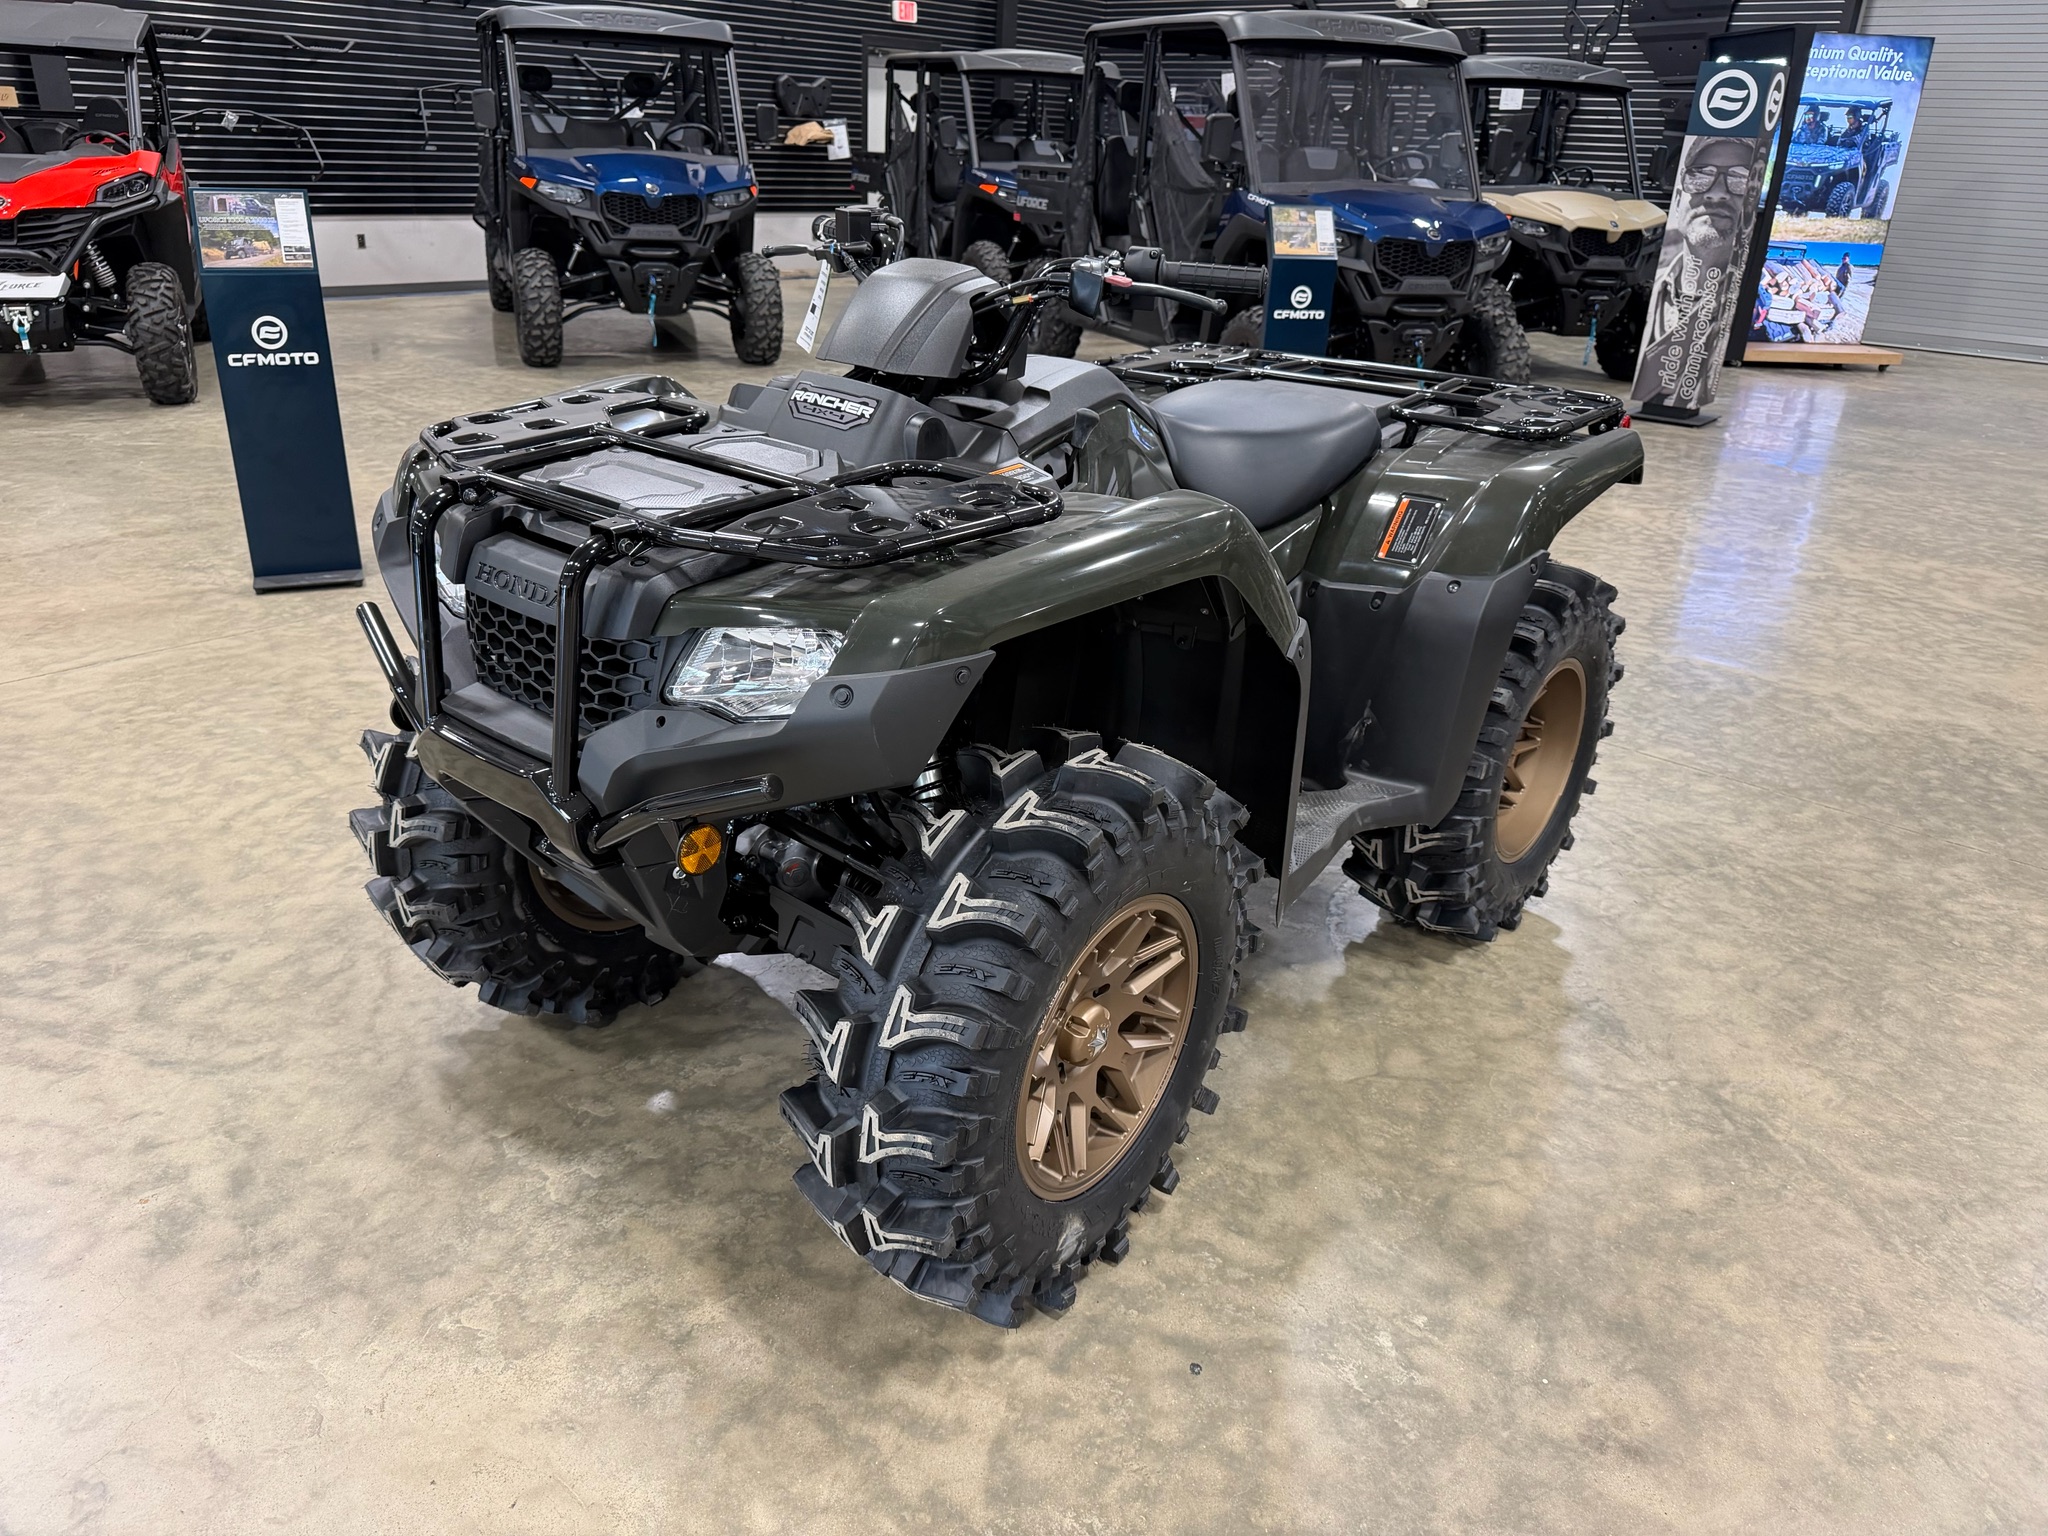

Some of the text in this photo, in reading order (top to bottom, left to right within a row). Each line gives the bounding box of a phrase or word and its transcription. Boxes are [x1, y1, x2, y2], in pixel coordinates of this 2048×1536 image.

[580, 12, 661, 27] CFMOTO
[898, 2, 915, 20] EXIT
[1847, 45, 1904, 67] Quality.
[1874, 65, 1916, 82] Value.
[1016, 195, 1049, 210] UFORCE
[1273, 309, 1326, 320] CFMOTO
[1658, 254, 1703, 390] ride without
[1680, 267, 1722, 400] compromise
[227, 351, 320, 367] CFMOTO
[790, 389, 875, 419] RANCHER
[1389, 511, 1403, 538] WARNING
[934, 963, 997, 983] EFX
